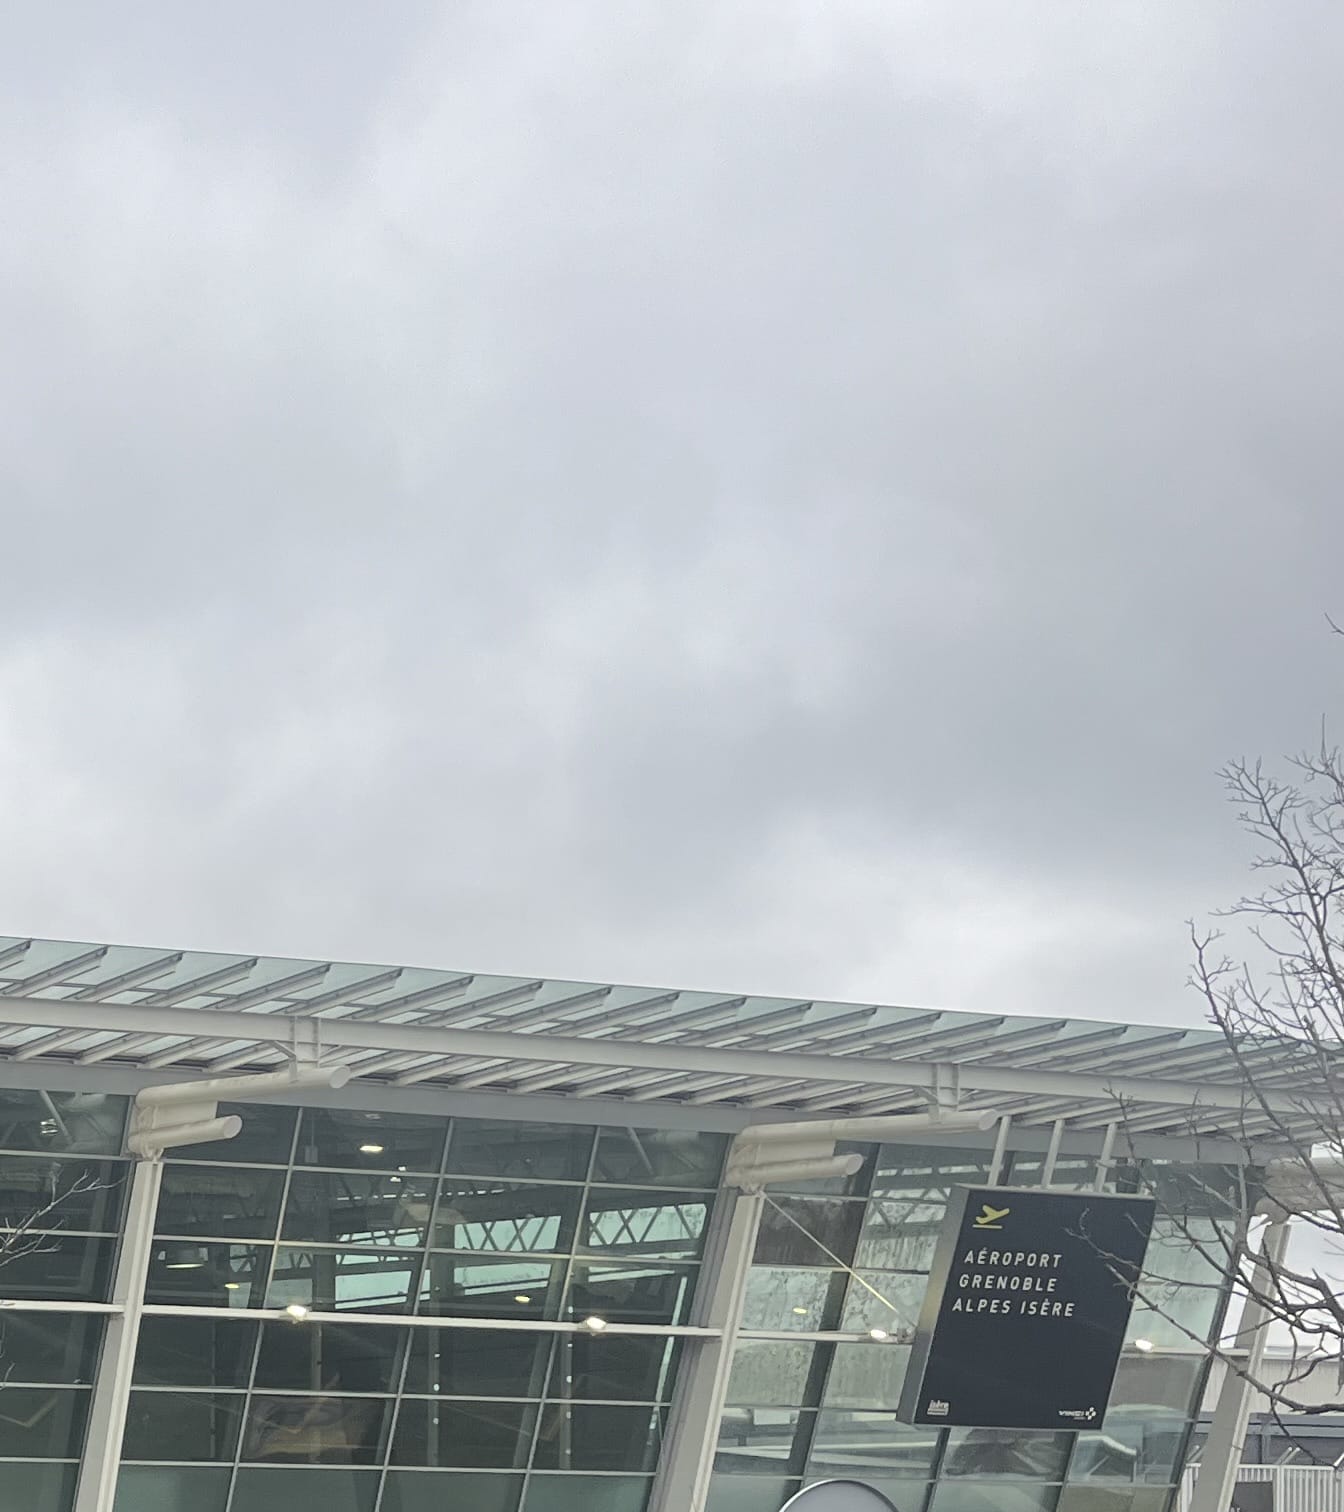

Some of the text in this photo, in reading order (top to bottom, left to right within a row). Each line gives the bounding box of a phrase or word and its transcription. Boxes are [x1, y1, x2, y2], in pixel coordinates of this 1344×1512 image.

[964, 1247, 1062, 1268] AÉROPORT
[959, 1274, 1057, 1292] GRENOBLE
[952, 1298, 1075, 1317] ALPES ISÈRE
